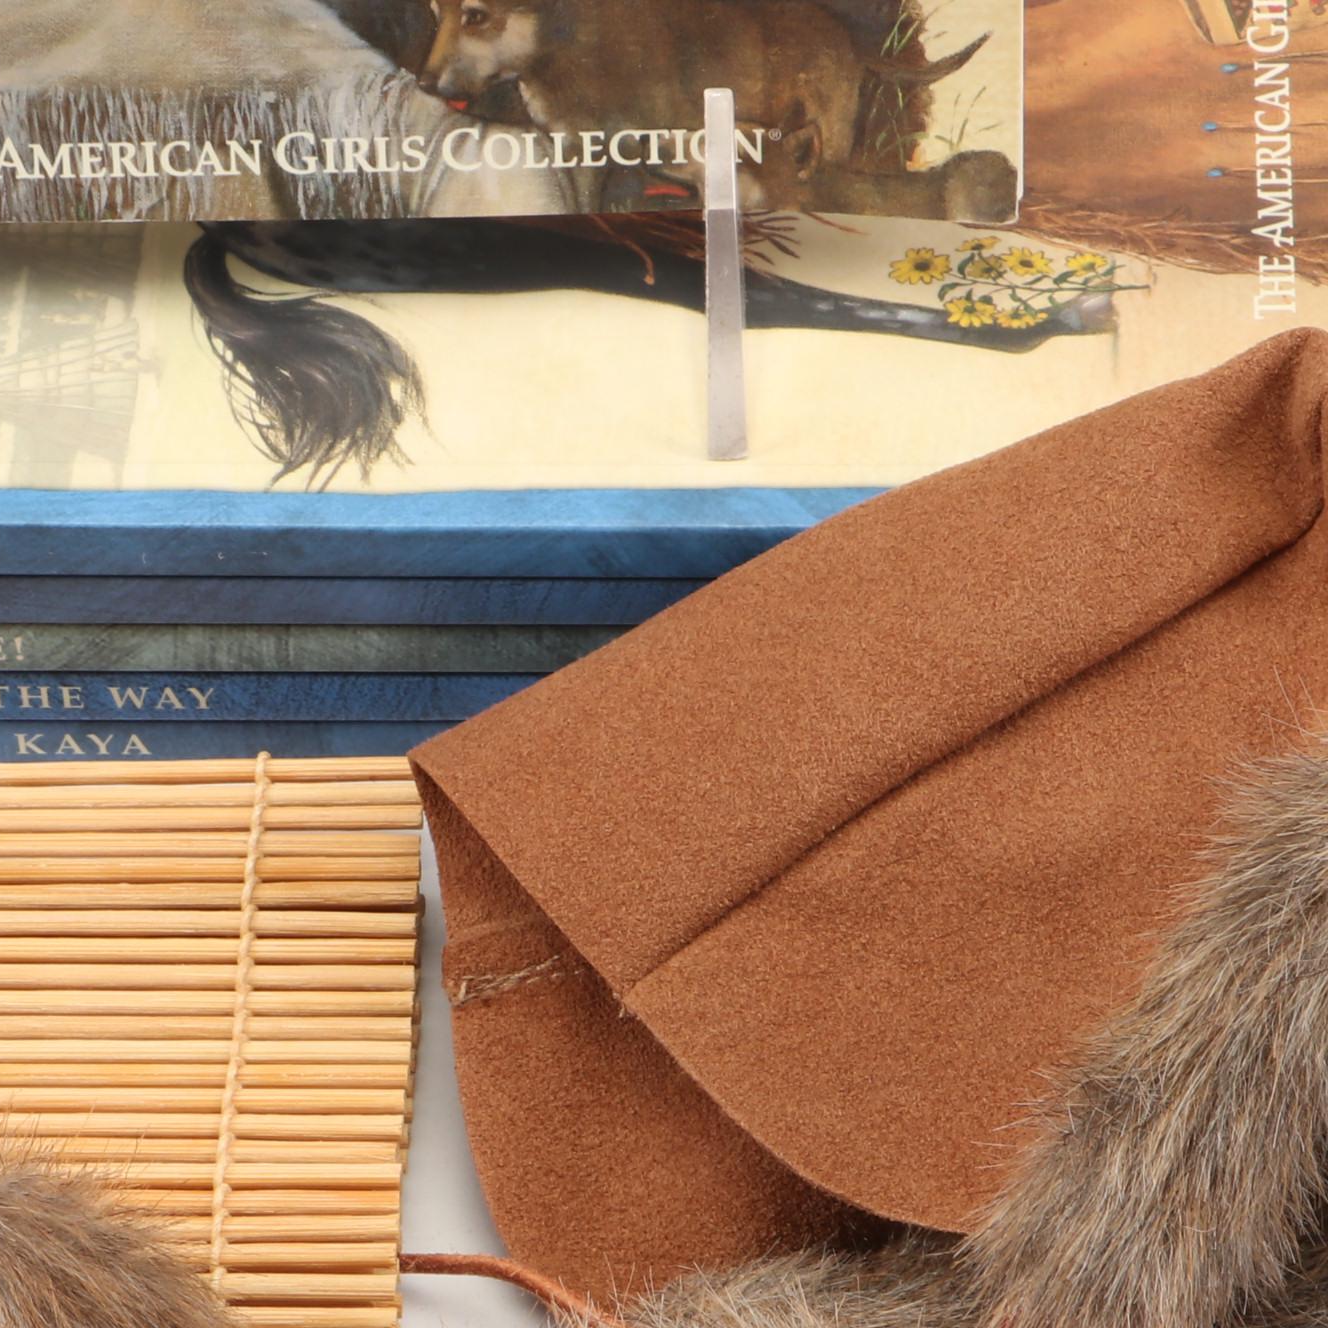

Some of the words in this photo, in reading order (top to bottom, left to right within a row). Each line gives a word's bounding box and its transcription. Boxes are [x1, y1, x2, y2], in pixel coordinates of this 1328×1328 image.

[1247, 0, 1290, 53] GI
[274, 131, 429, 175] GIRLS
[1251, 61, 1295, 248] AMERICAN
[1254, 255, 1297, 320] THE
[107, 686, 215, 711] WAY
[15, 733, 152, 756] KAYA
